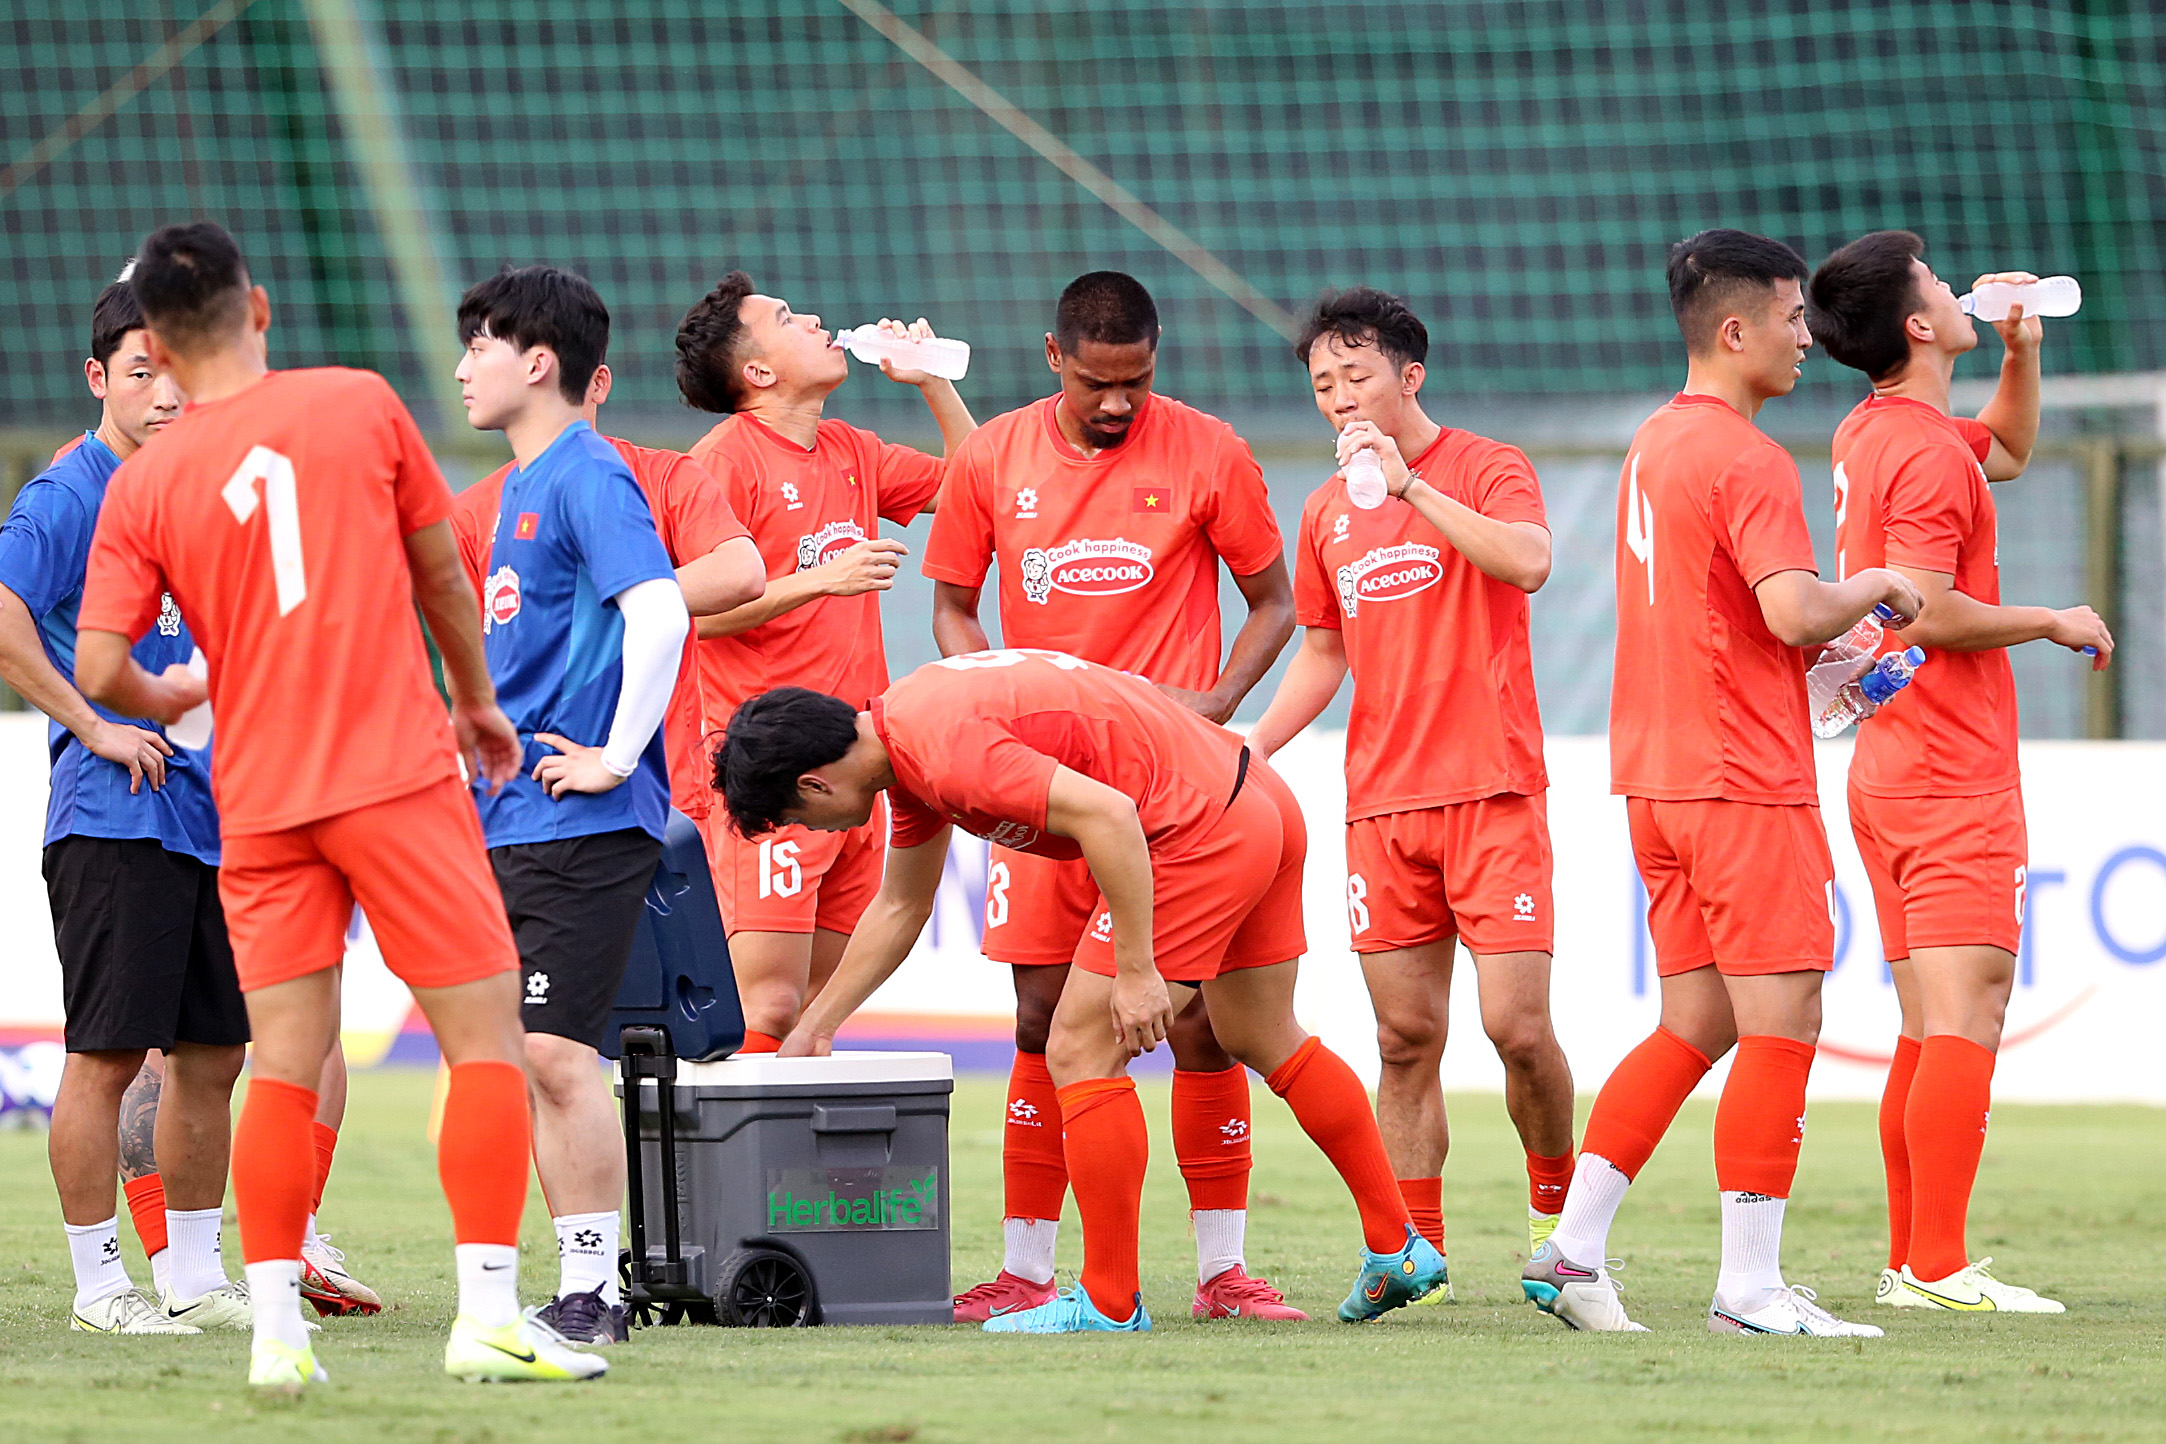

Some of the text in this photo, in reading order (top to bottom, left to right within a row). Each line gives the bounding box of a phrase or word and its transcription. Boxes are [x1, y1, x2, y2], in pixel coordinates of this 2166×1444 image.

[816, 526, 832, 546] Cook
[1626, 450, 1655, 606] 4
[1048, 541, 1149, 562] Cook happiness
[1352, 545, 1437, 575] Cook happiness
[759, 839, 803, 900] 15
[1347, 872, 1371, 936] 8
[769, 1188, 923, 1226] Herbalife
[1735, 1194, 1772, 1204] adidas
